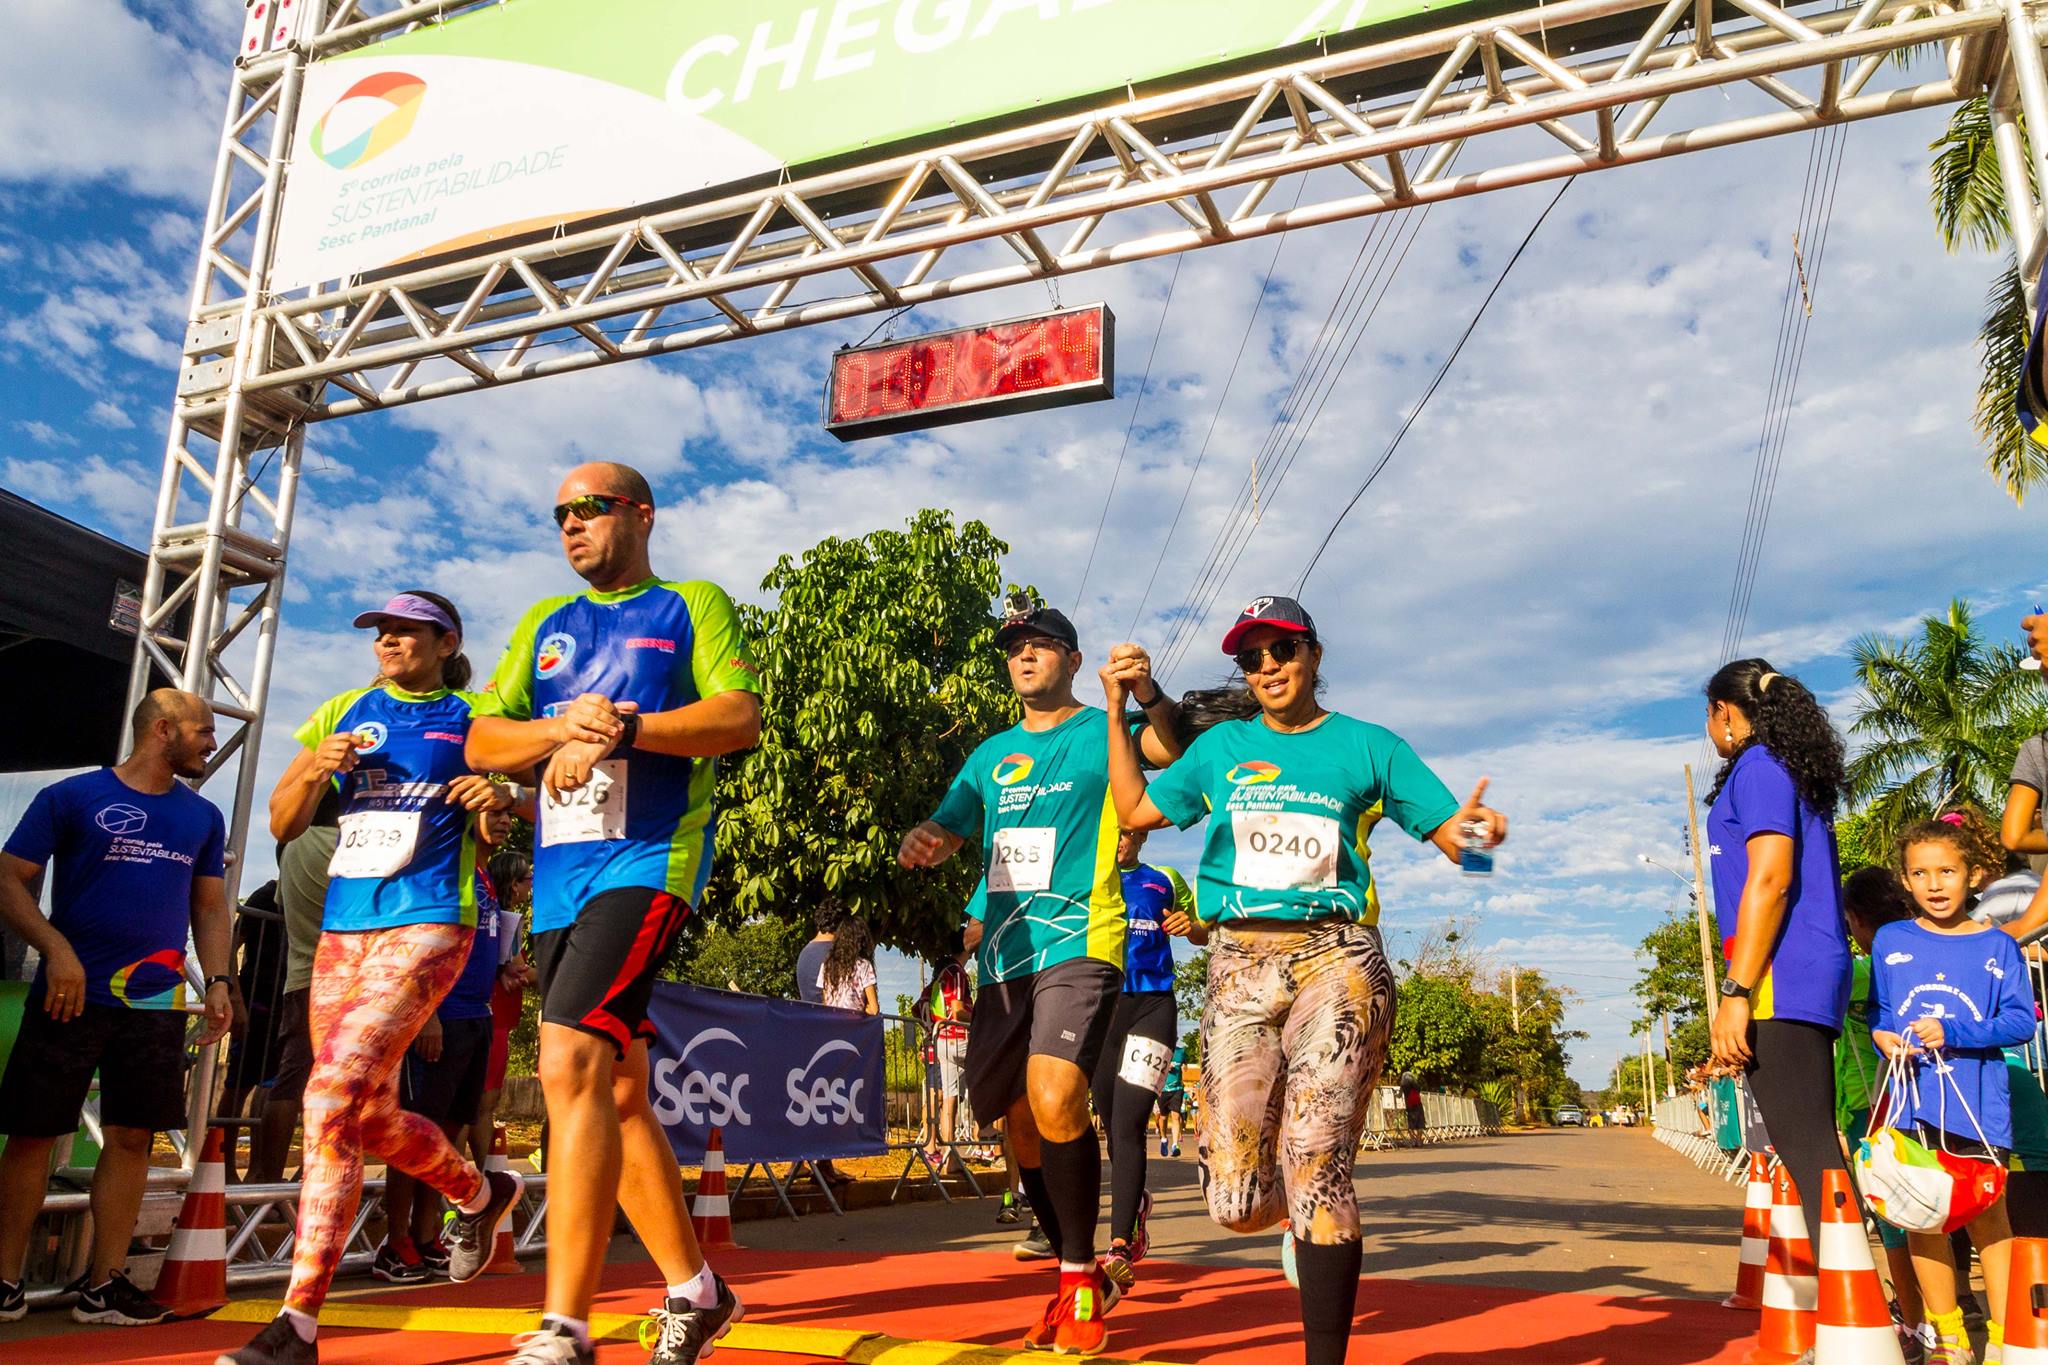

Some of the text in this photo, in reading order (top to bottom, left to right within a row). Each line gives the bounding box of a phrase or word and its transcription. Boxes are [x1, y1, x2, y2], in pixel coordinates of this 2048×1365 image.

[664, 0, 1115, 115] CHEG
[327, 144, 569, 228] SUSTENTABILIDADE
[360, 163, 421, 192] corrida
[424, 151, 464, 178] pela
[317, 207, 437, 252] Sesc Pantanal
[1230, 789, 1344, 813] SUSTENTABILIDADE
[108, 845, 194, 866] SUSTENTABILIDADE
[1249, 831, 1322, 860] 0240
[653, 1056, 865, 1127] Sesc Sesc
